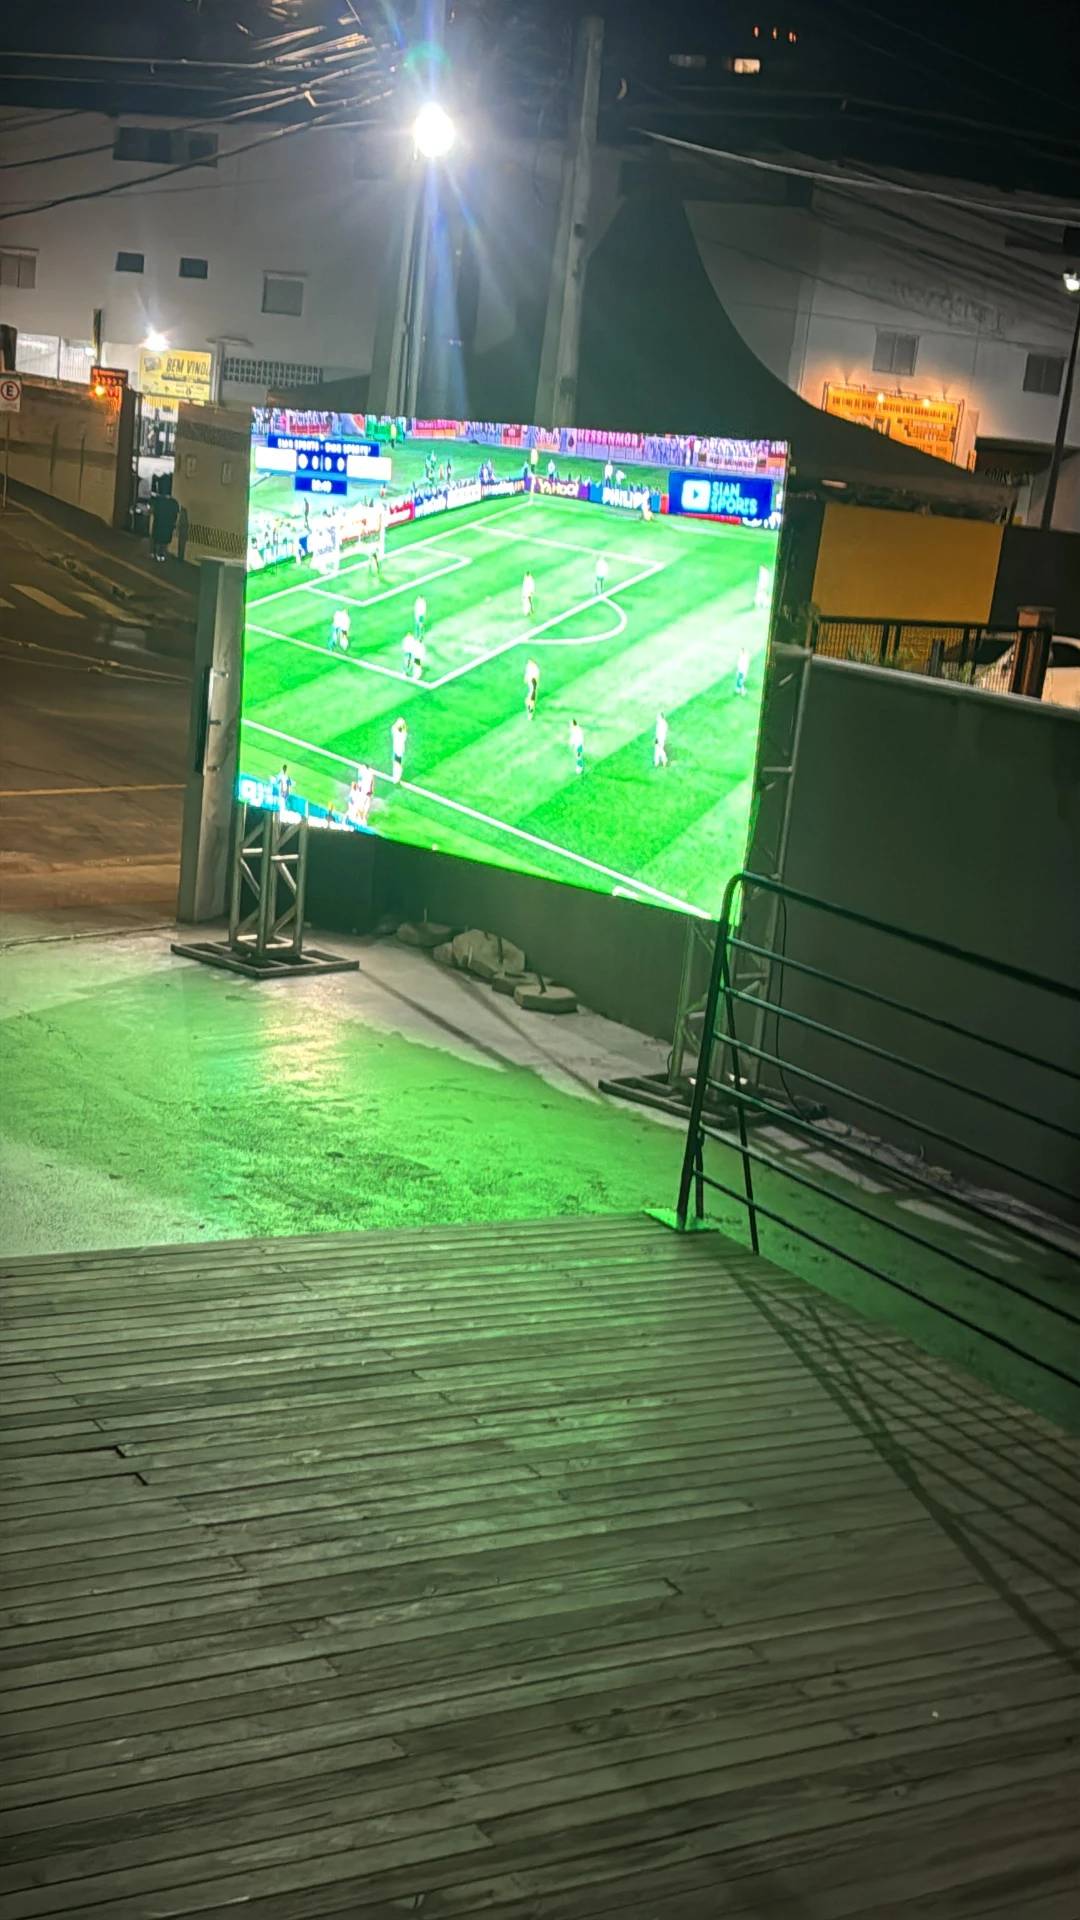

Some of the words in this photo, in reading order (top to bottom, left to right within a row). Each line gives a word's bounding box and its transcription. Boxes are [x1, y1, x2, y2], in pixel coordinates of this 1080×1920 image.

[167, 357, 185, 375] BEM
[712, 481, 741, 497] SIAN
[711, 495, 758, 515] SPORTS
